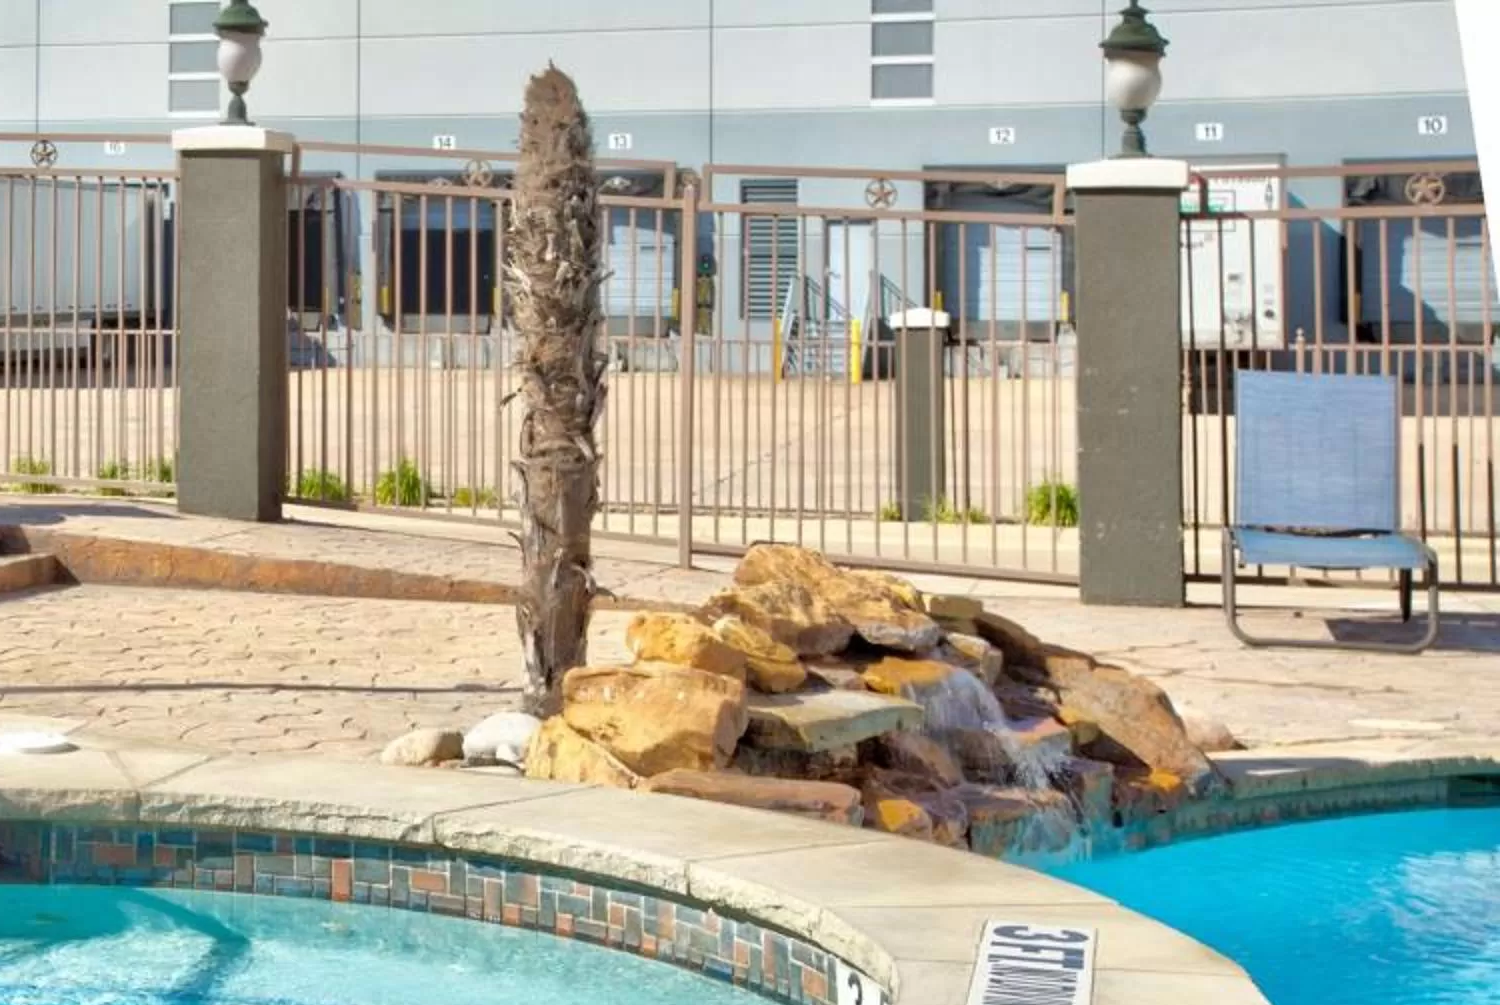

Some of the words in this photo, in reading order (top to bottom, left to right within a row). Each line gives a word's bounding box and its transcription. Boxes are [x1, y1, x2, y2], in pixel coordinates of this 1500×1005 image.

[1424, 118, 1443, 133] 10
[438, 137, 452, 148] 14
[995, 129, 1011, 142] 12
[993, 925, 1090, 943] 3
